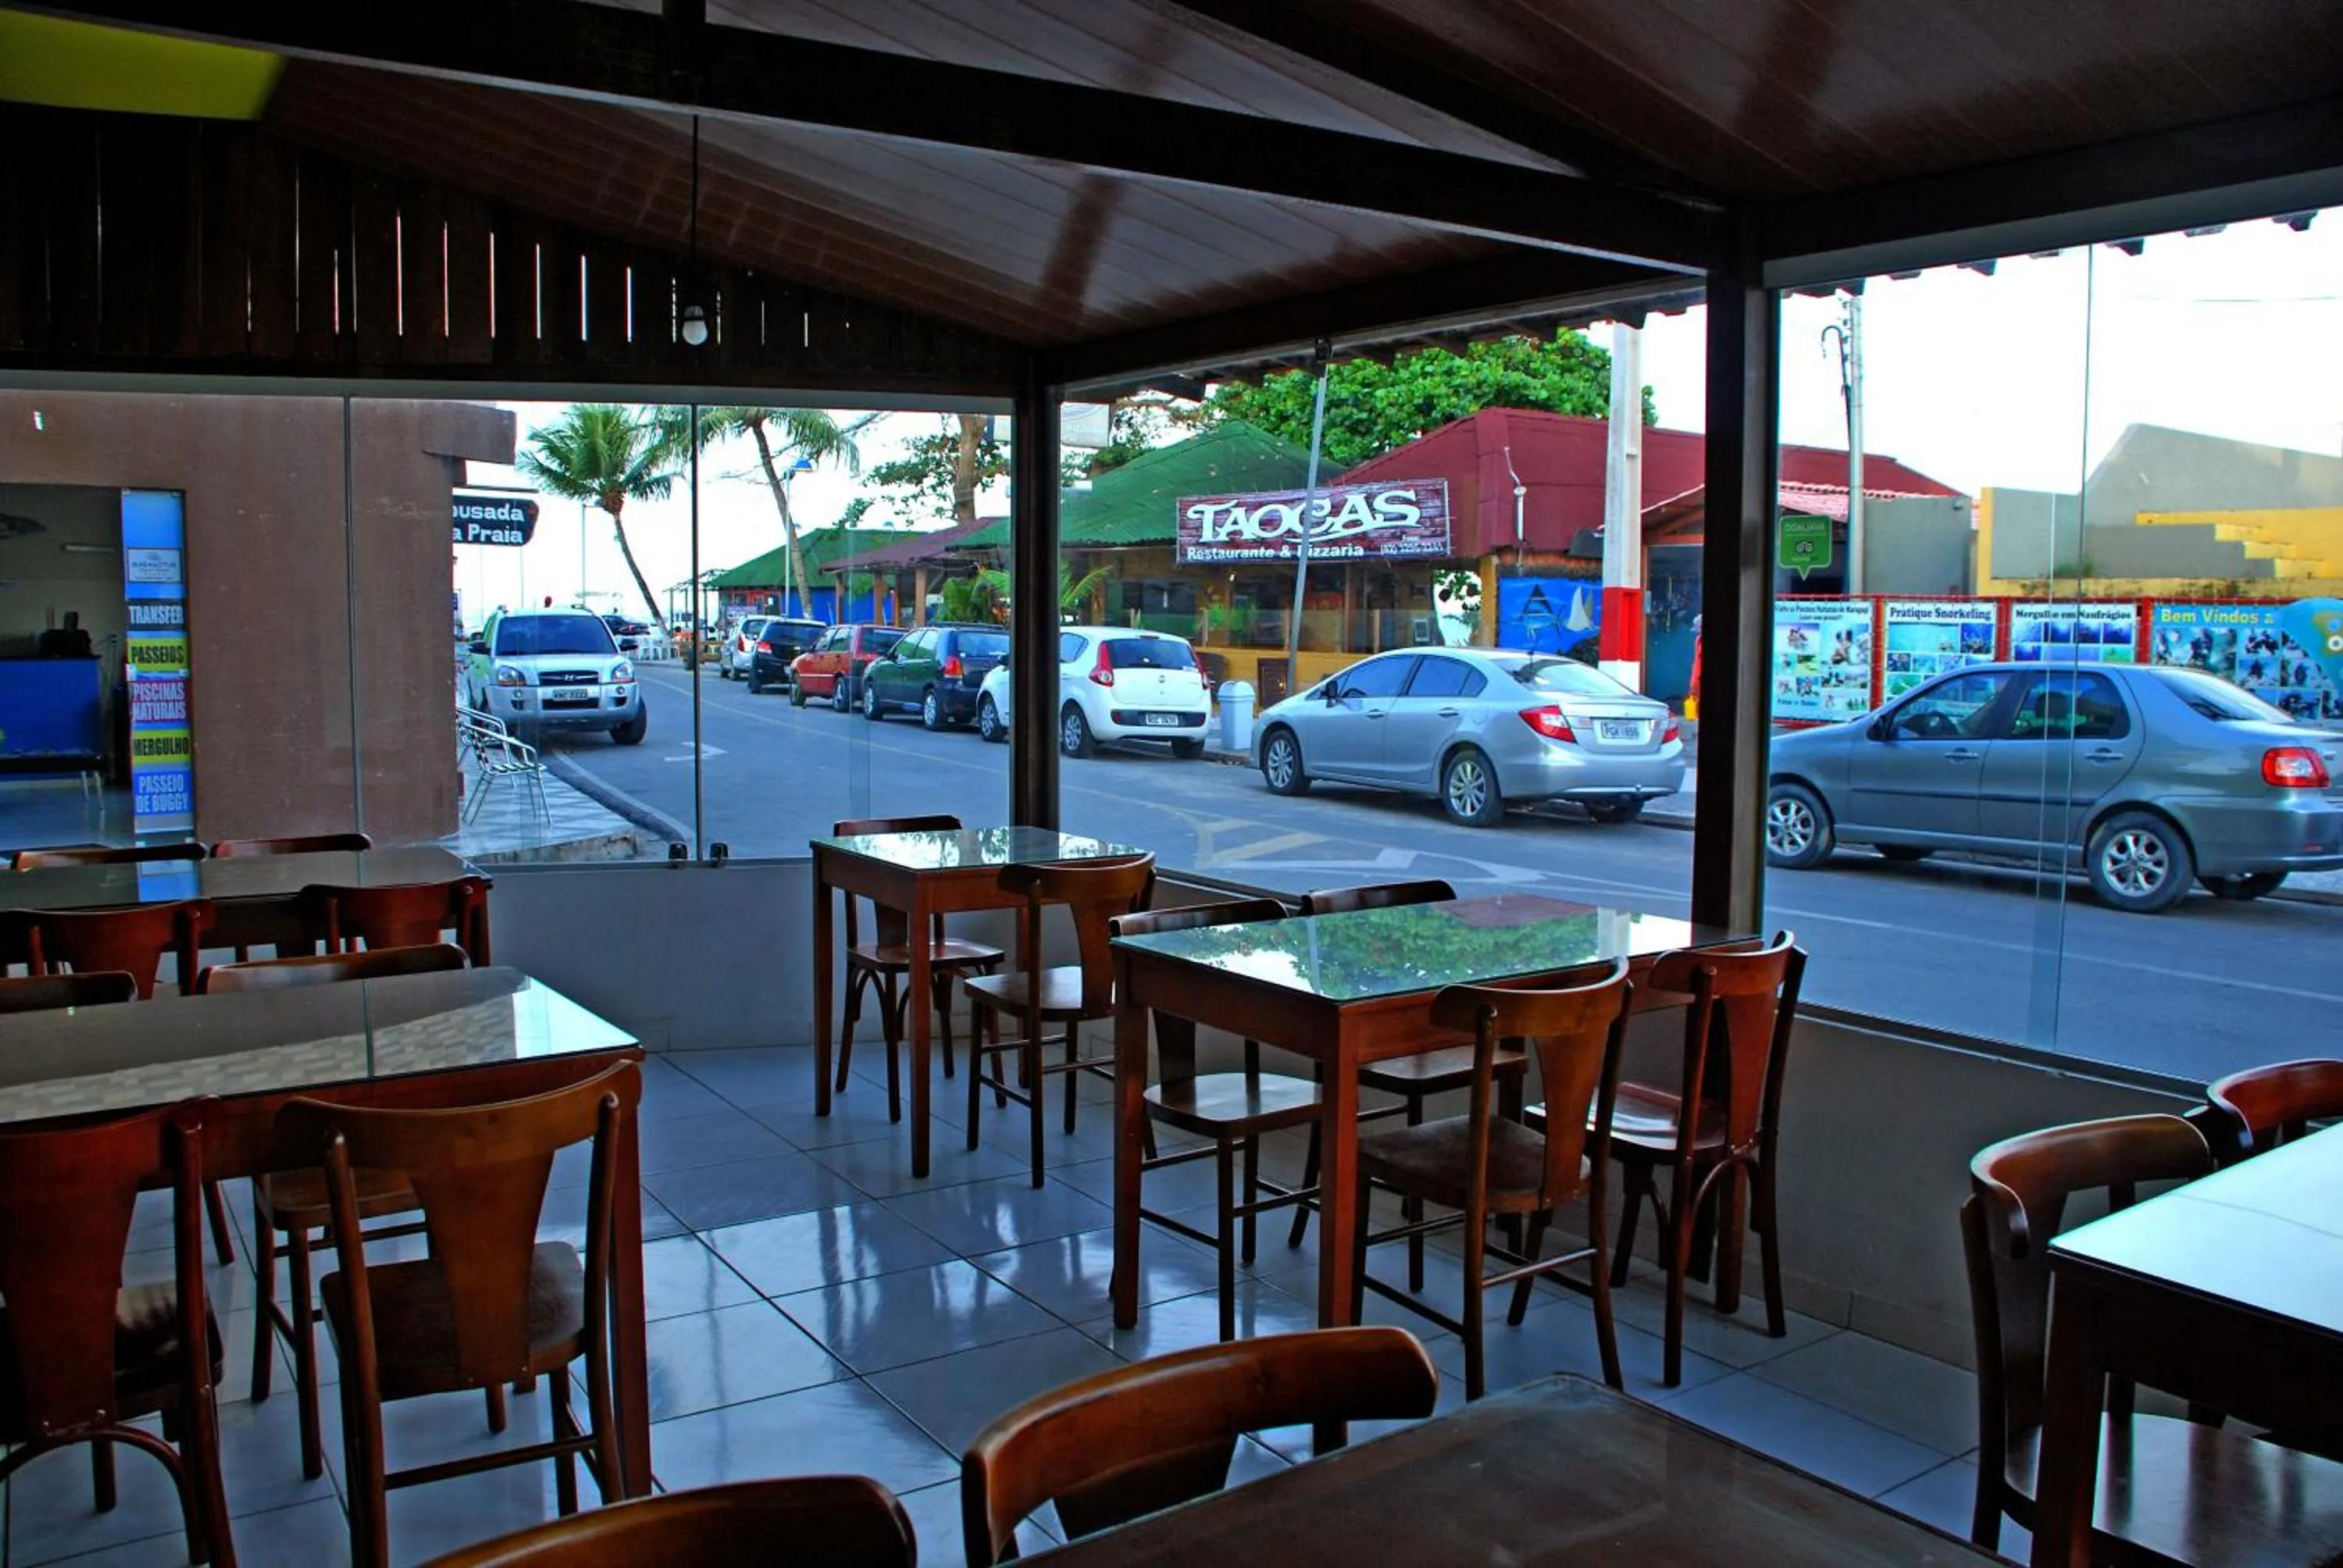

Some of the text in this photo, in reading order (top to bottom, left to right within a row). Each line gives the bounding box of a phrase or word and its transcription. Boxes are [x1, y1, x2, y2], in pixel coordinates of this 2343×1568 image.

[1186, 490, 1424, 543] TAOCAS
[468, 523, 523, 543] Praia
[1186, 547, 1275, 560] Restaurante
[1280, 545, 1291, 558] &
[128, 605, 184, 624] TRANSFER
[1889, 607, 1992, 621] Pratique Snorkeling
[2078, 609, 2131, 621] Naufrágios
[2161, 608, 2275, 624] Bem Vindos a
[131, 645, 184, 664] PASSEIOS
[132, 682, 184, 700] PISCINAS
[133, 700, 187, 721] NATURAIS
[133, 737, 190, 756] MERGULHO
[139, 774, 184, 794] PASSEIO
[137, 793, 188, 813] DE BUGGY
